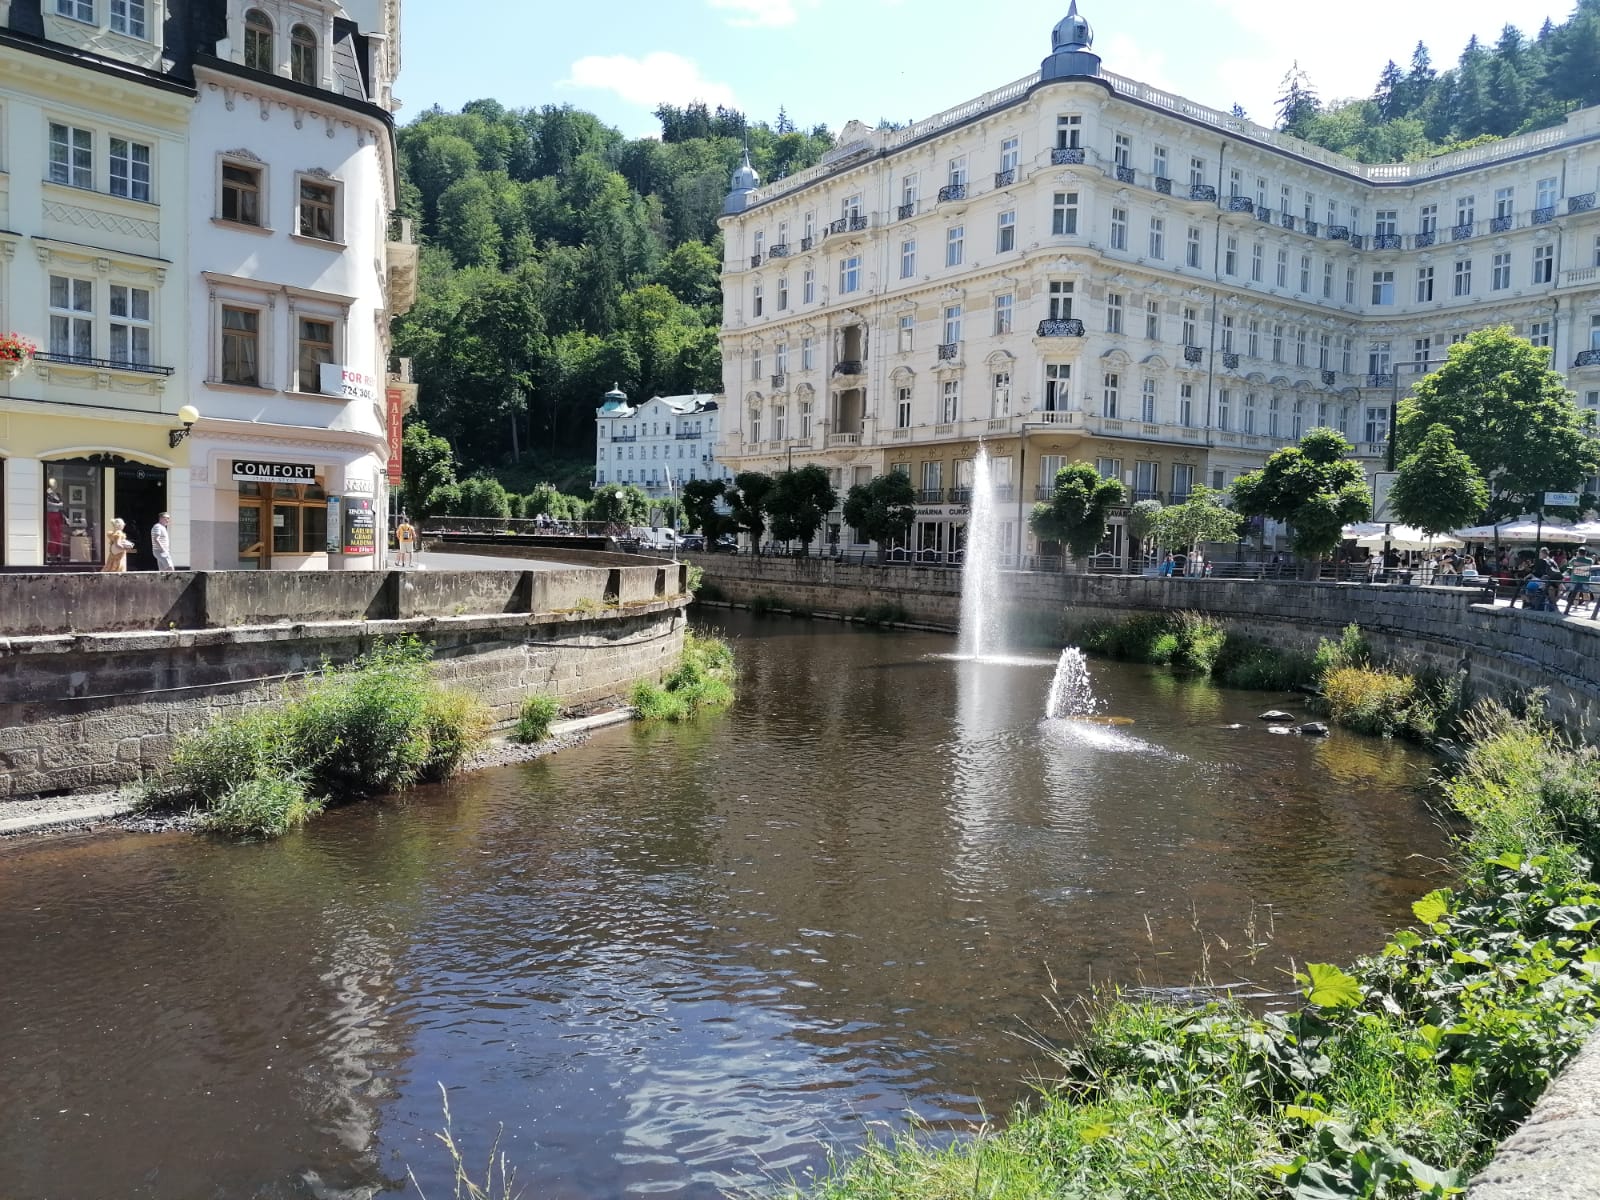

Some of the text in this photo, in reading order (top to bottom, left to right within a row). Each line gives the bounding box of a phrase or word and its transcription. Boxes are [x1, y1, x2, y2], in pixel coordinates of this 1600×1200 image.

[342, 370, 362, 384] FOR
[341, 385, 358, 396] 724
[391, 402, 399, 460] ALISA
[234, 462, 314, 478] COMFORT
